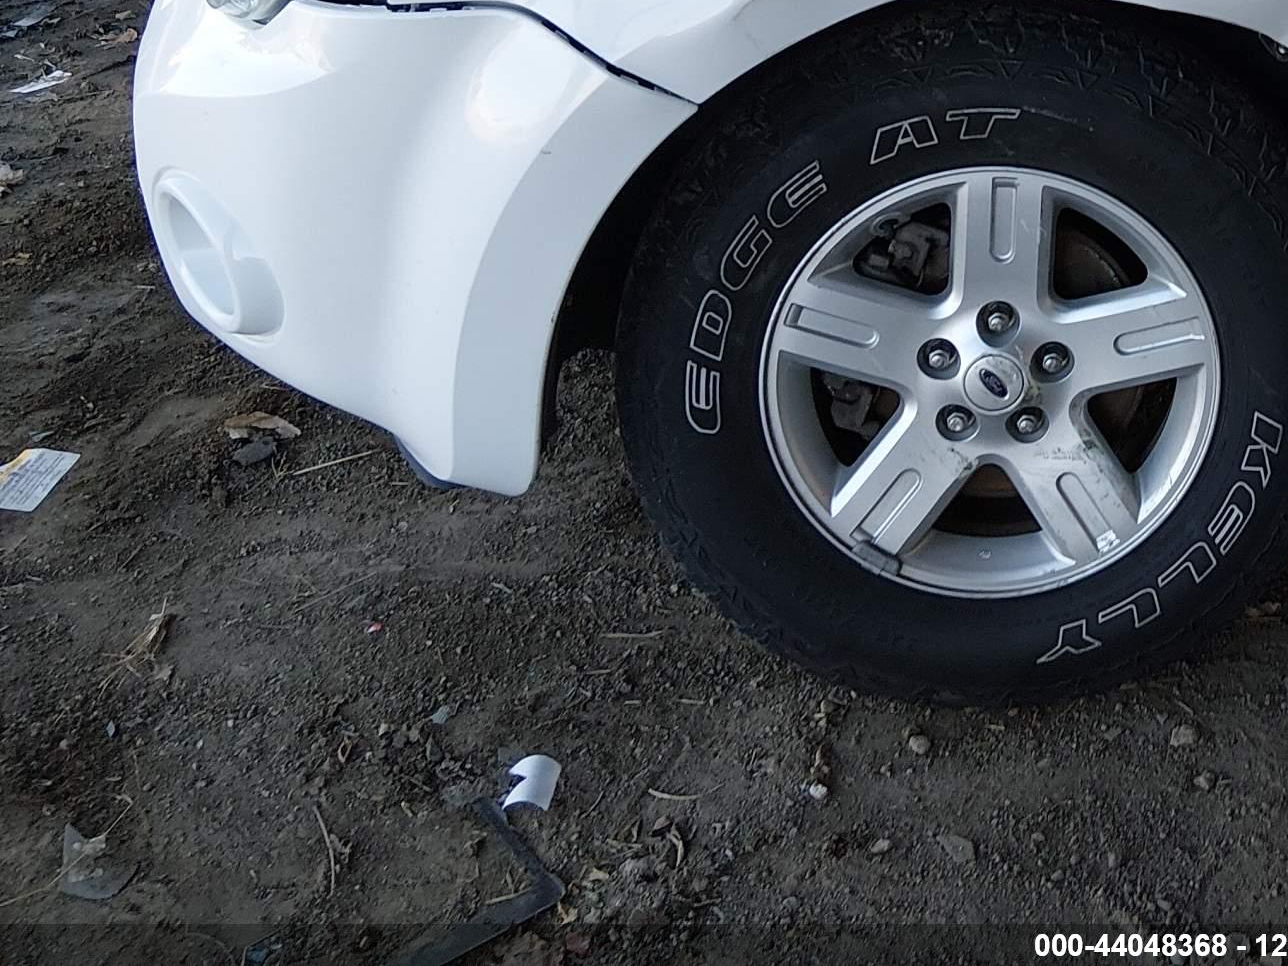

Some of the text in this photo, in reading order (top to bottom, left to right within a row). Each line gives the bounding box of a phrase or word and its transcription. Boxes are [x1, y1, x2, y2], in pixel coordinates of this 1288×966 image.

[685, 107, 1022, 434] EDGE AT
[1036, 411, 1284, 664] KELLY
